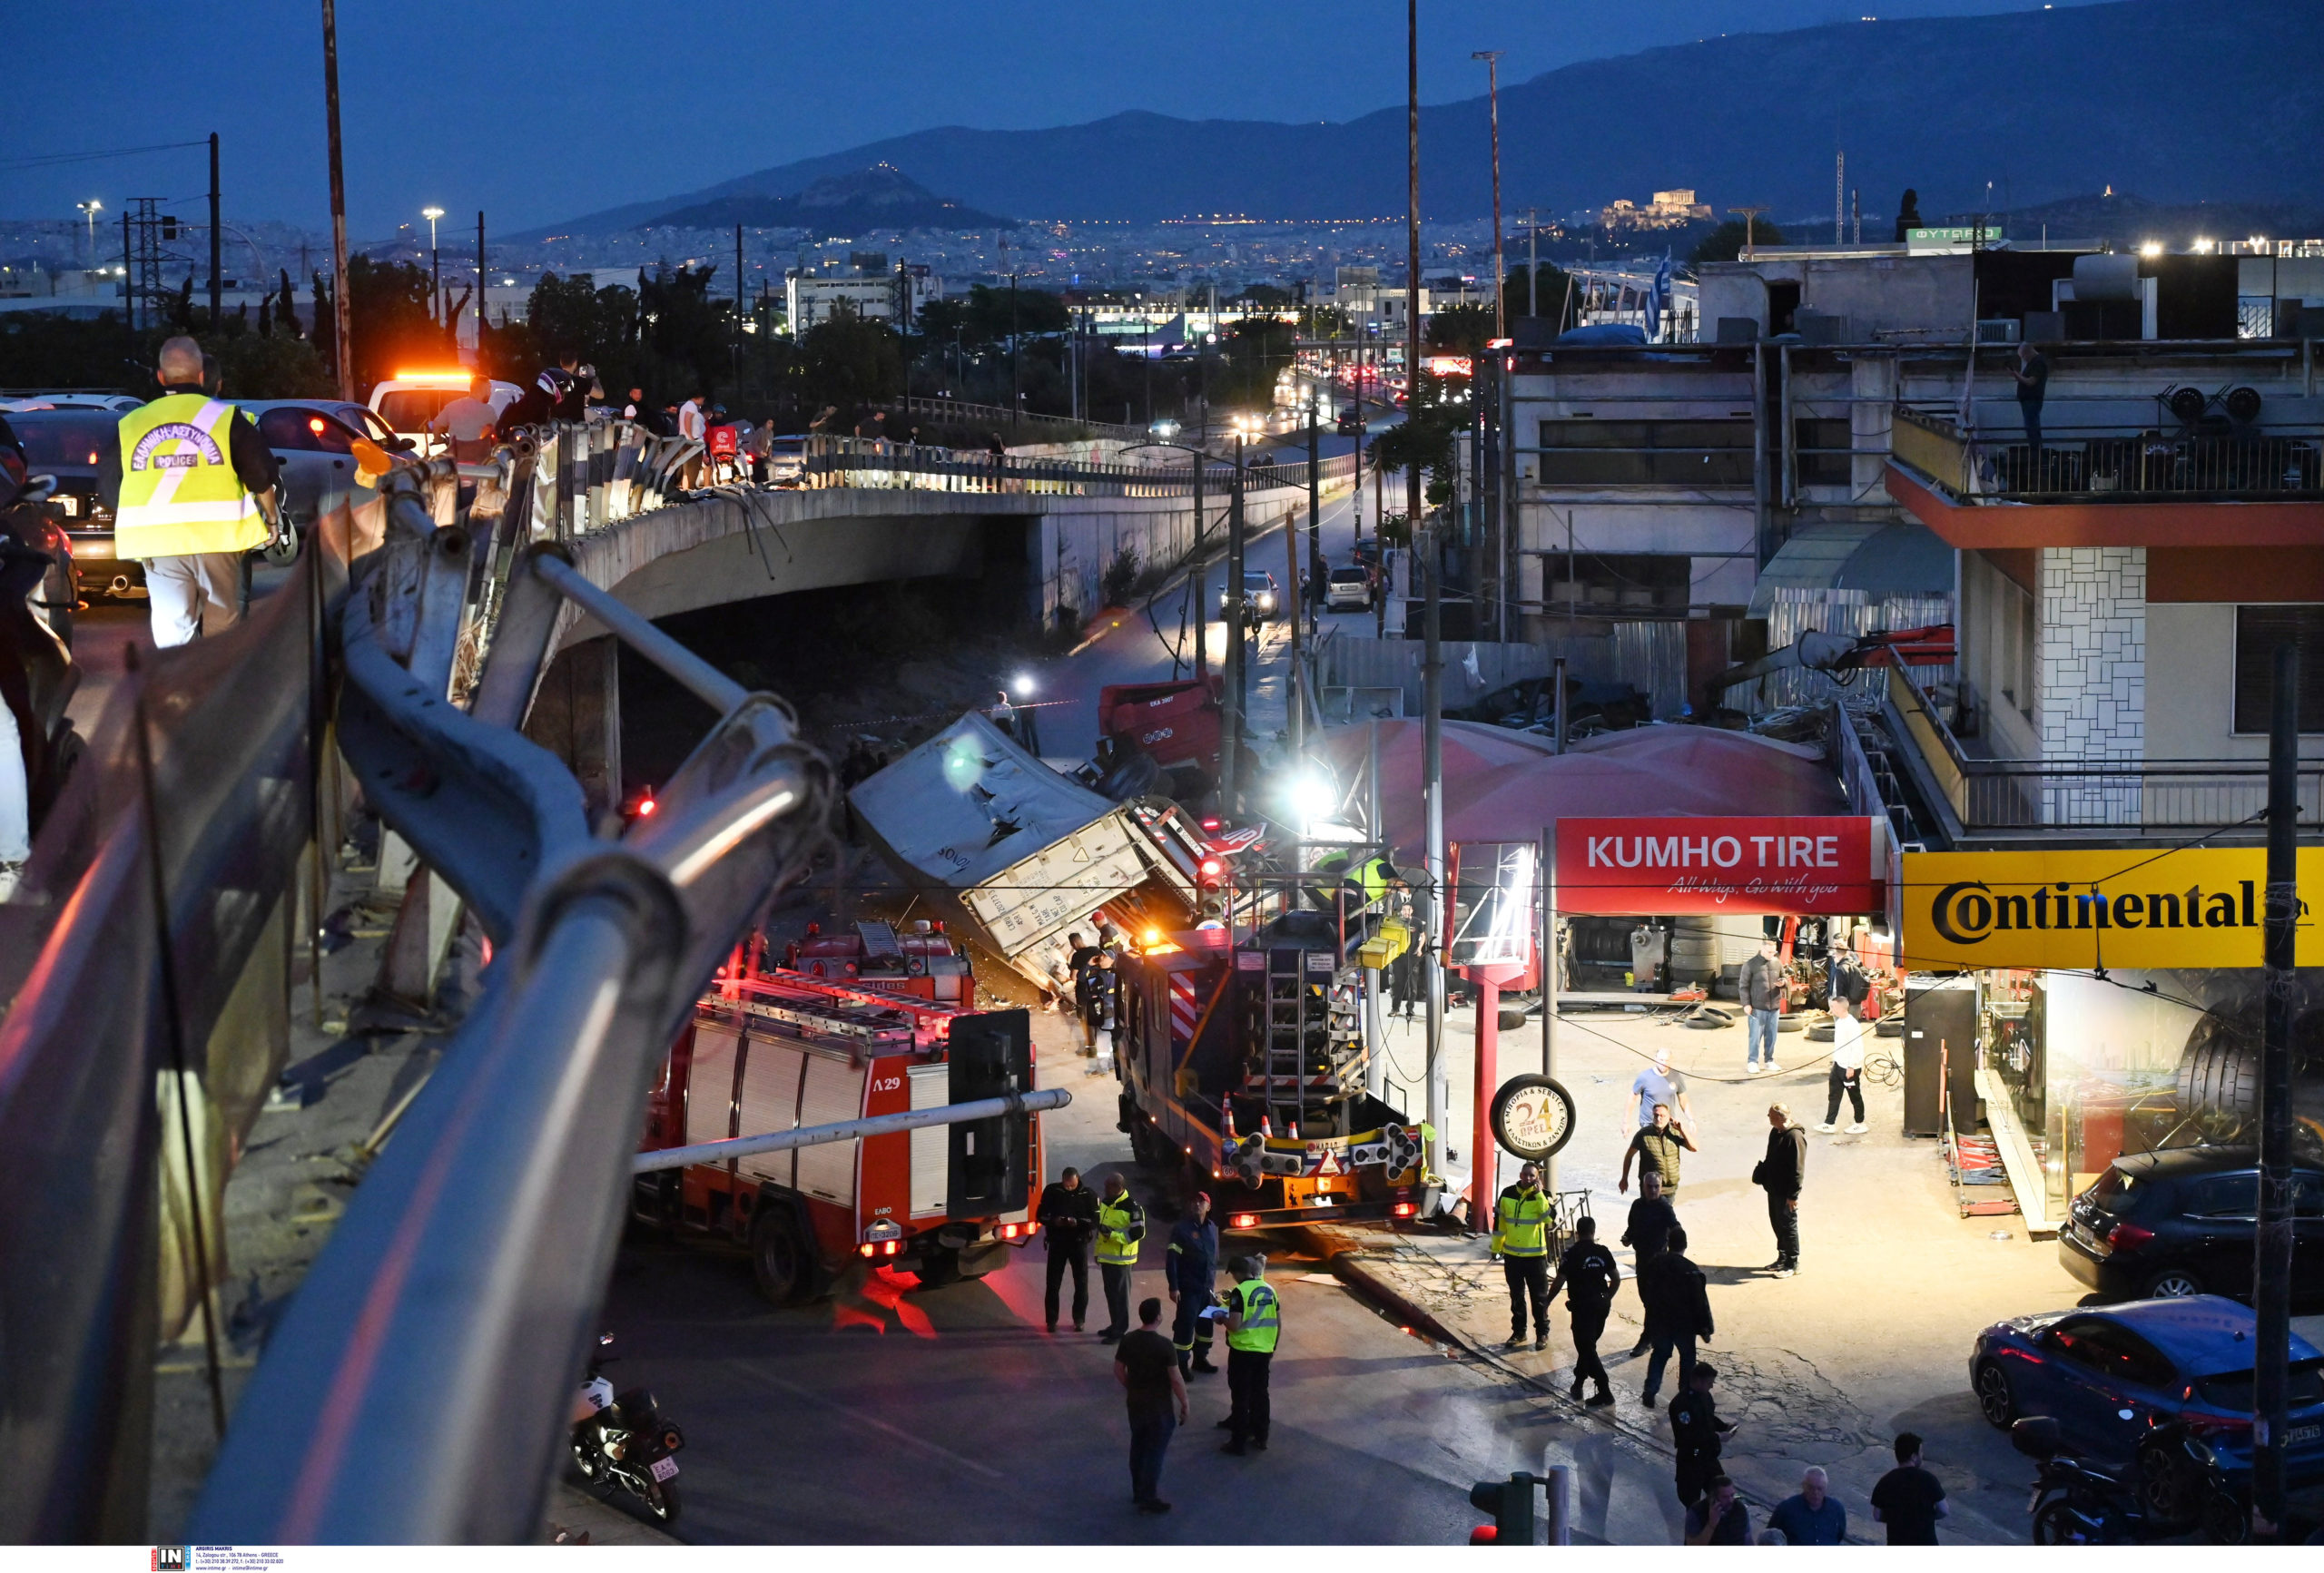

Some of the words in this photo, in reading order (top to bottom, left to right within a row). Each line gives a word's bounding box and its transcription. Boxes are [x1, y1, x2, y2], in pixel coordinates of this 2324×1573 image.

[159, 456, 192, 467] POLICE
[1588, 836, 1741, 868] KUMHO
[1750, 836, 1838, 867] TIRE
[1746, 877, 1769, 894] Go
[1805, 884, 1838, 903] you
[1932, 880, 2259, 945] Continental
[884, 1077, 901, 1090] 29
[1505, 1090, 1529, 1124] ΕΜΠΟΡΙΑ
[1537, 1088, 1565, 1112] SERVICE
[1515, 1097, 1553, 1132] 24
[1508, 1127, 1541, 1148] ΕΛΑΣΤΙΚΩΝ
